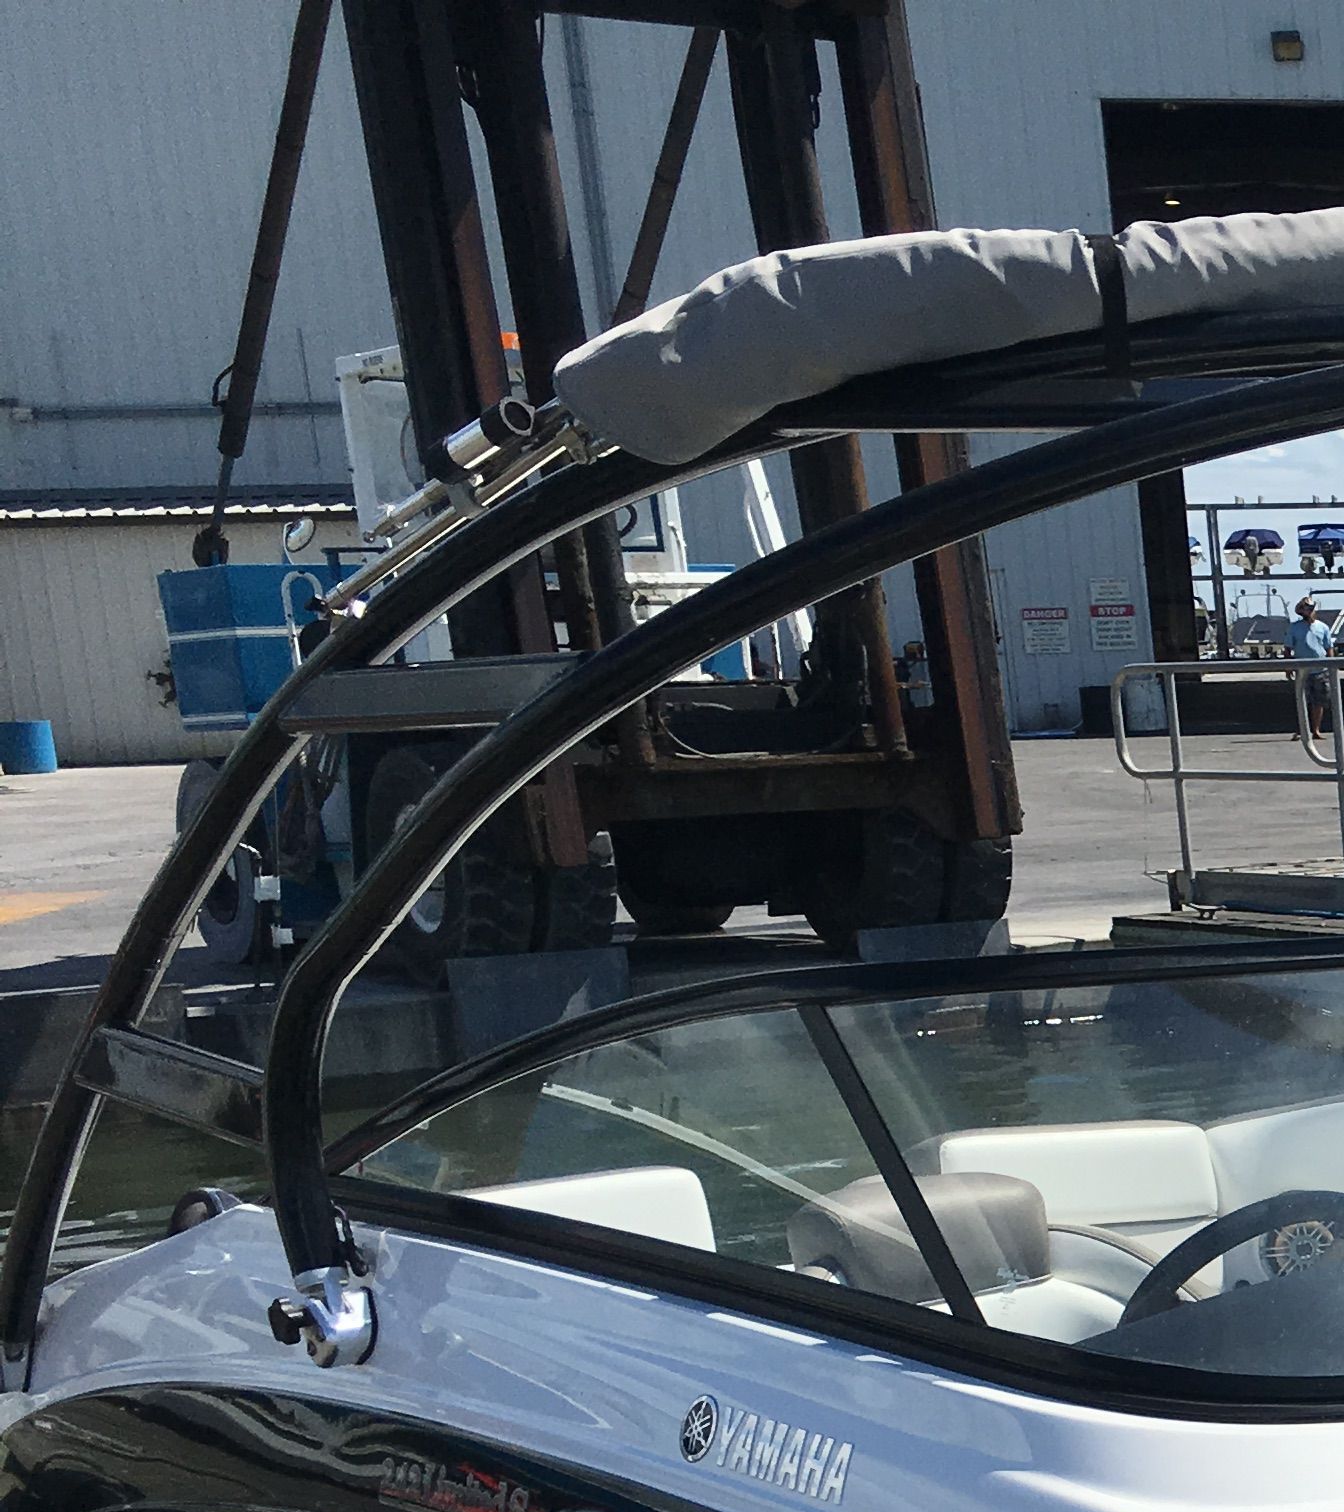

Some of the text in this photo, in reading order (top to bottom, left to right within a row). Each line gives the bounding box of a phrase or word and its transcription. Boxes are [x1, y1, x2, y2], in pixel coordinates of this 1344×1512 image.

[1023, 610, 1065, 618] DANGER
[1097, 607, 1127, 615] STOP
[716, 1406, 854, 1505] YAMAHA
